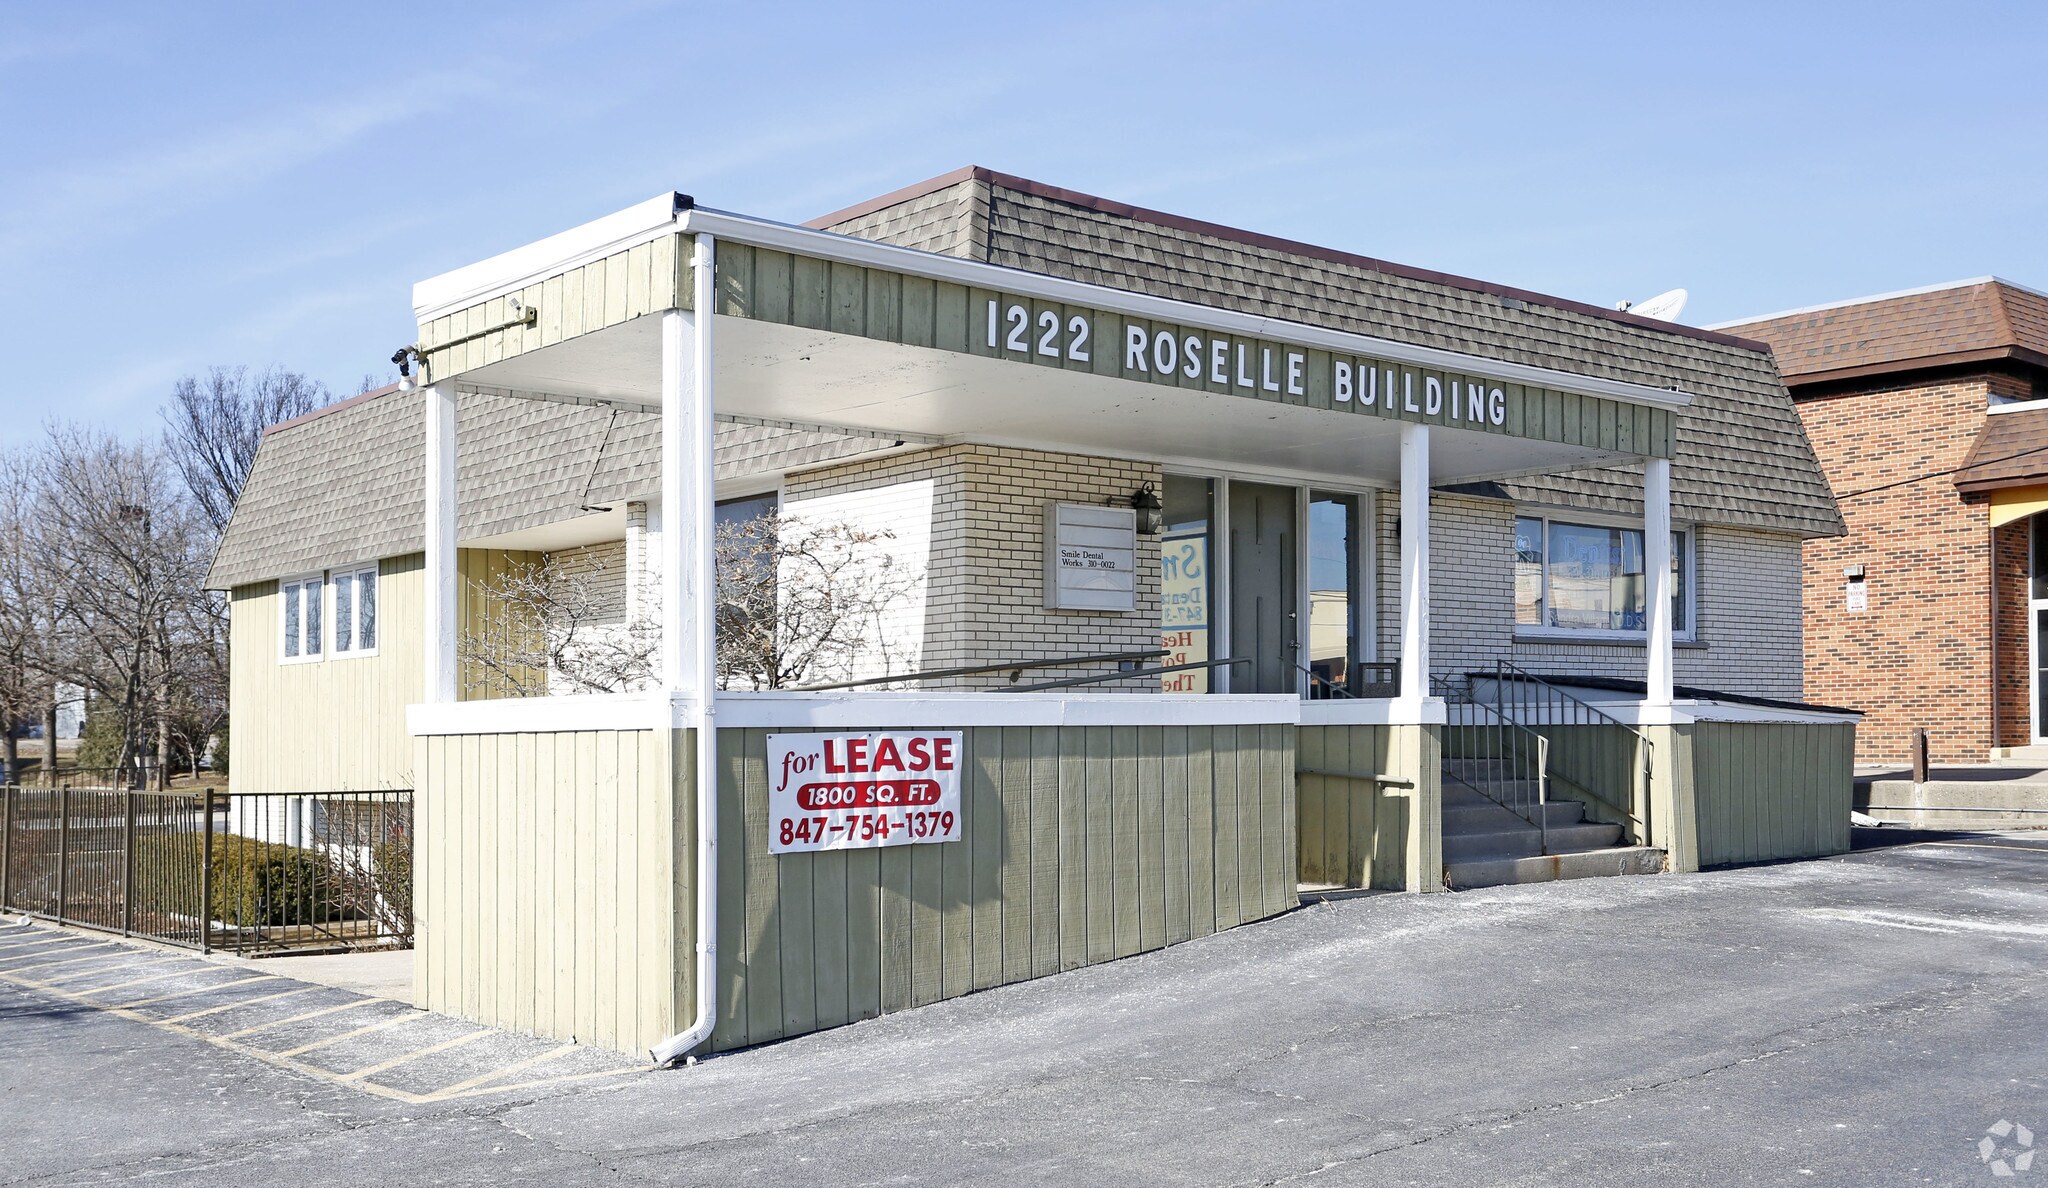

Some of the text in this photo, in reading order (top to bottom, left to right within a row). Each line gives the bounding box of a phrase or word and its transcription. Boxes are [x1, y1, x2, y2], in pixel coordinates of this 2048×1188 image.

[987, 300, 1506, 426] 1222 ROSELLE BUILDING
[1061, 549, 1104, 560] Smile Dental
[1062, 558, 1115, 569] Works 310-0022
[776, 737, 954, 792] for LEASE
[808, 783, 932, 806] 1800 SQ. FT.
[779, 810, 954, 846] 847-754-1379
